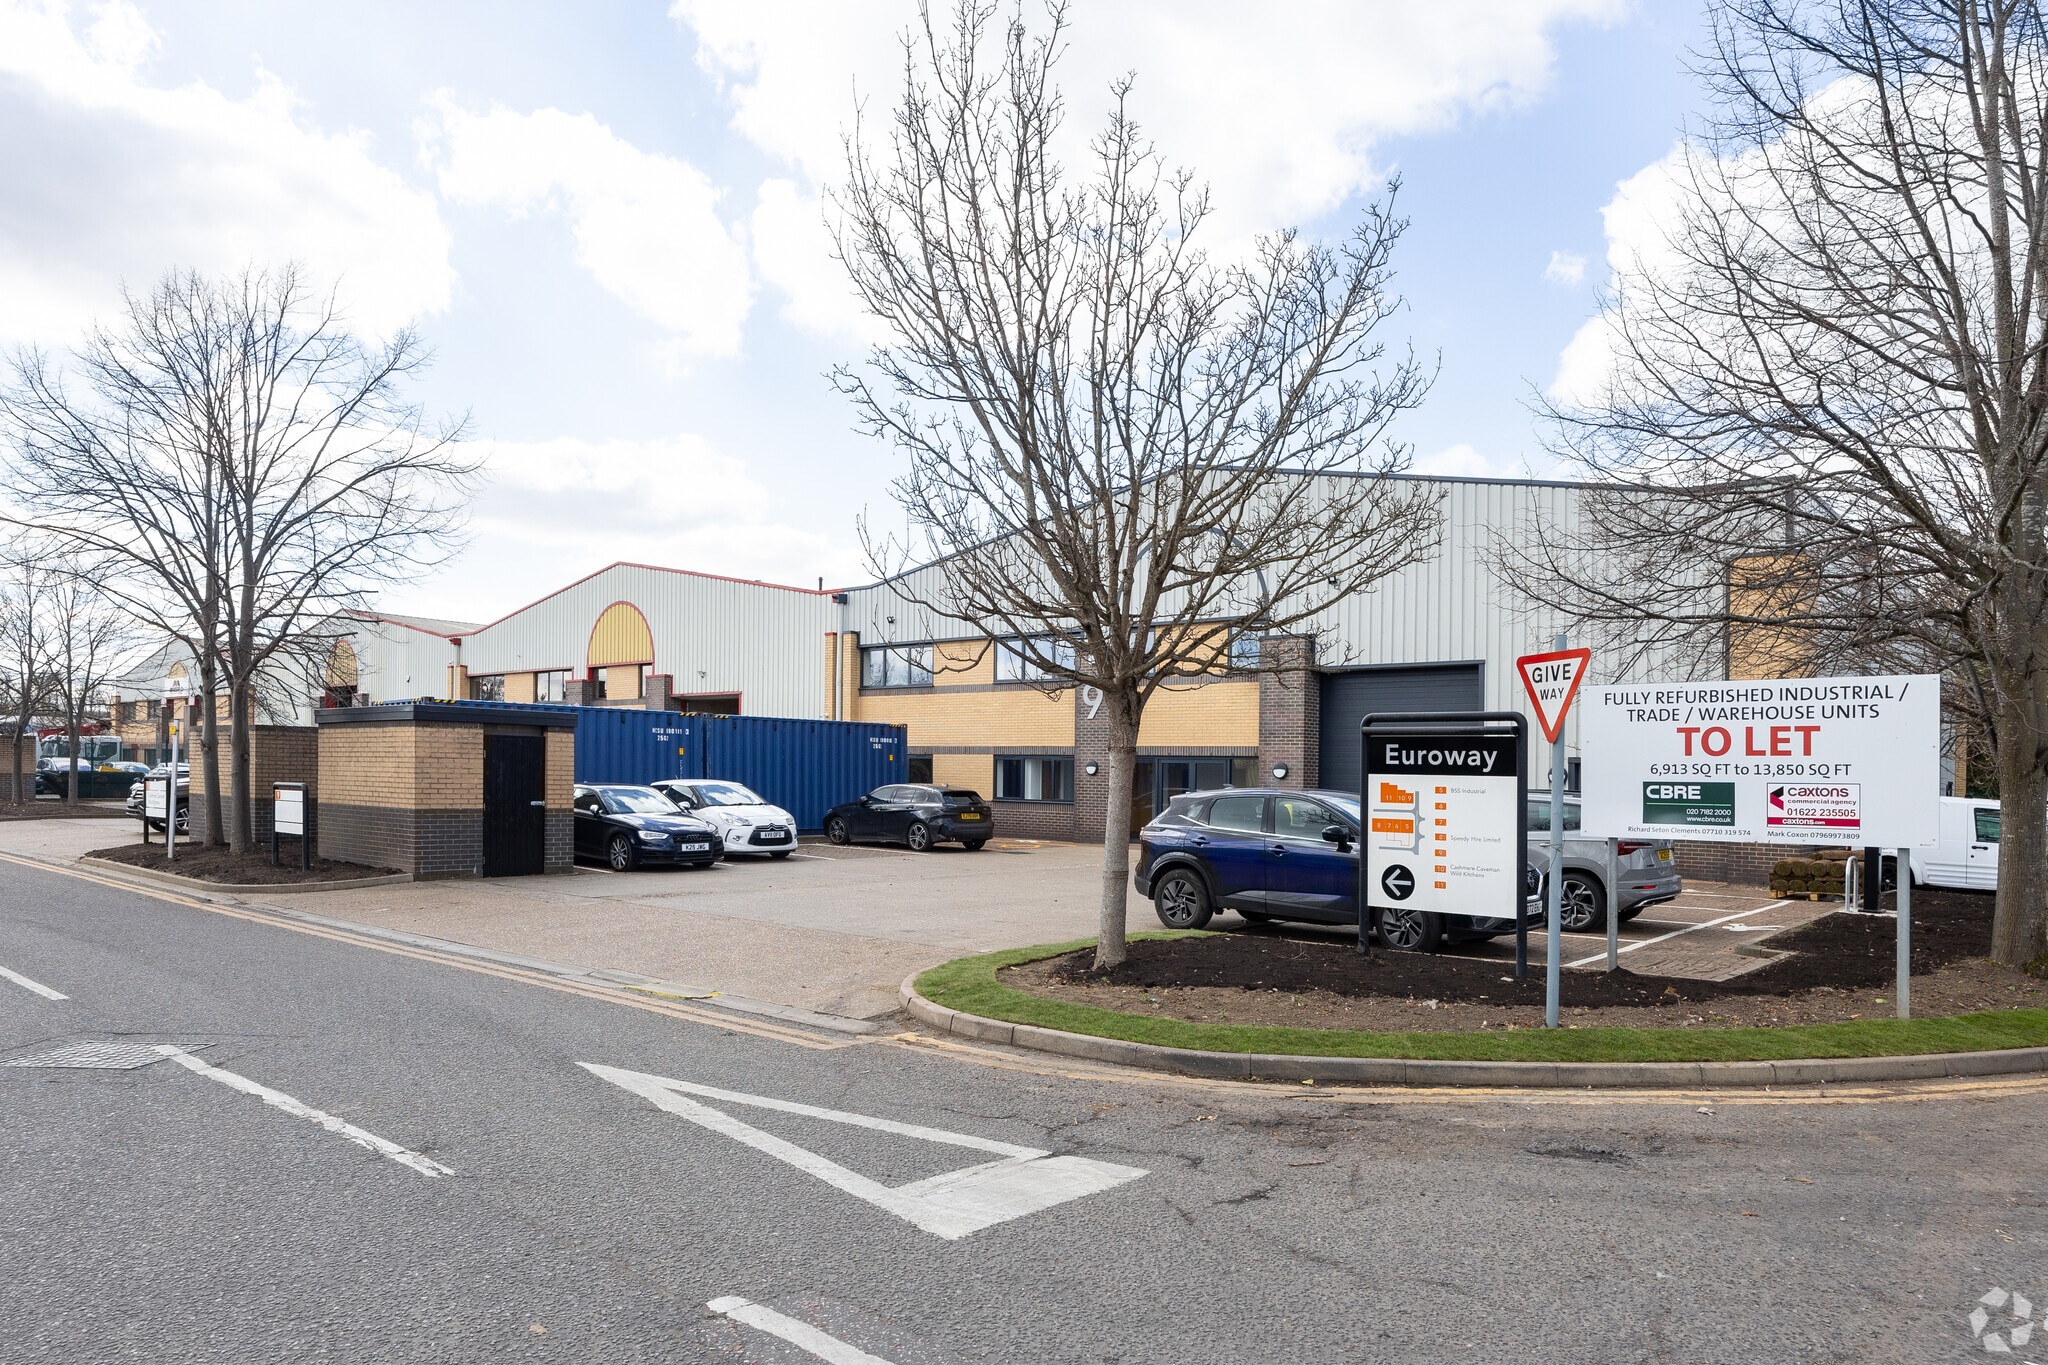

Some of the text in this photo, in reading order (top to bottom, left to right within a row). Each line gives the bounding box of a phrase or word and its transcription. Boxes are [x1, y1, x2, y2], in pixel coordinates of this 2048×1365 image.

[1532, 663, 1571, 683] GIVE
[1083, 684, 1104, 720] 9
[1540, 687, 1565, 701] WAY
[1604, 683, 1909, 705] FULLY REFURBISHED INDUSTRIAL /
[1627, 704, 1880, 724] TRADE / WAREHOUSE UNITS
[1676, 725, 1821, 757] TO LET
[1385, 743, 1498, 773] Euroway
[1650, 763, 1852, 778] 6,913 SQ FT to 13,850 SQ FT
[1646, 785, 1702, 800] CBRE
[1787, 786, 1849, 798] caxtons
[1787, 808, 1856, 817] 01622 235505
[1810, 832, 1860, 840] 07969973809
